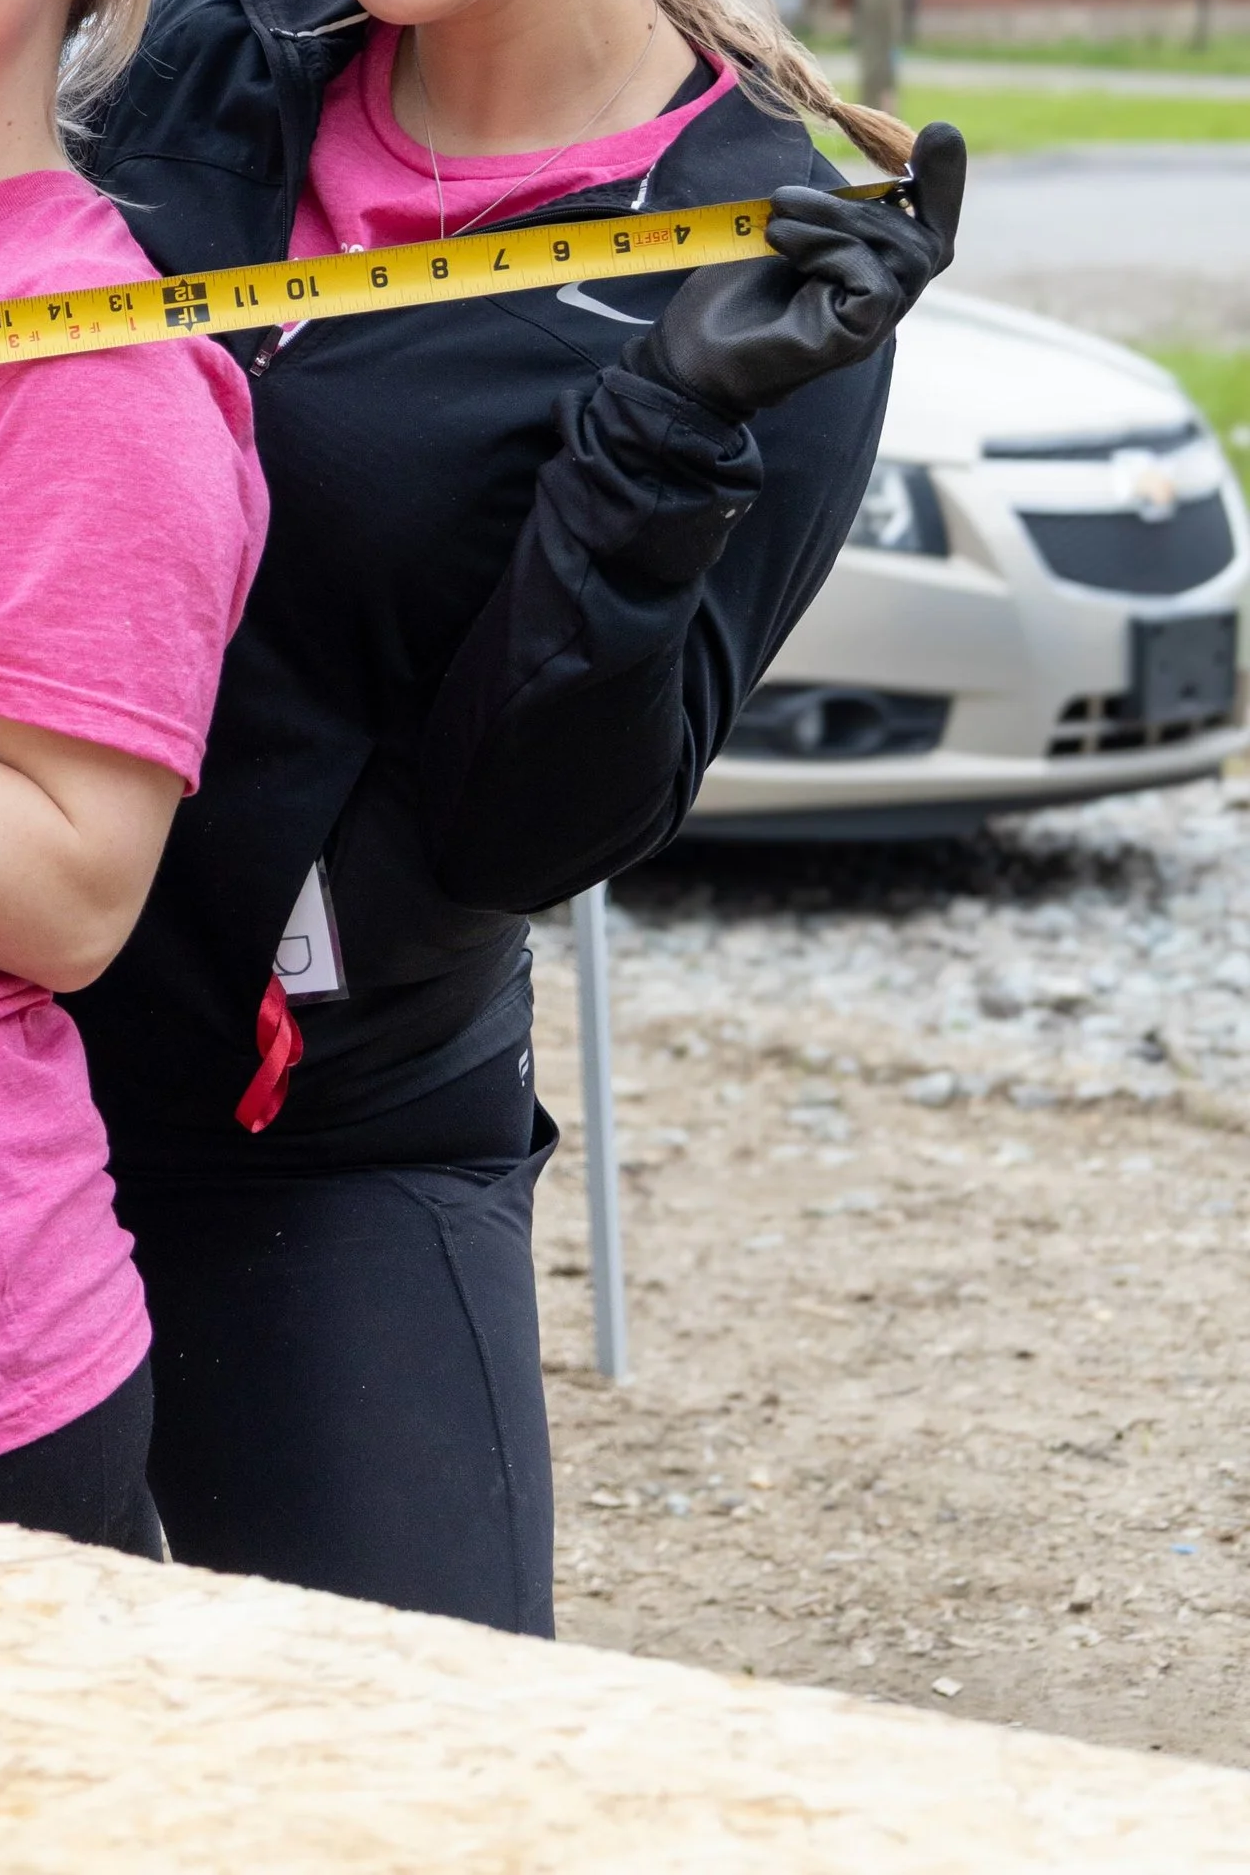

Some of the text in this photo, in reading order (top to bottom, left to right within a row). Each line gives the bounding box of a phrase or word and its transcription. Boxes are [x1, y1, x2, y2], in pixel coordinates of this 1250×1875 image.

[673, 224, 691, 246] 4
[734, 214, 752, 237] 3
[613, 232, 631, 254] 5
[635, 229, 670, 246] 25FT
[493, 248, 510, 271] 7
[552, 240, 570, 262] 6
[371, 266, 389, 288] 9
[431, 257, 449, 280] 8
[174, 285, 195, 302] 12
[234, 284, 259, 308] 11
[286, 275, 319, 300] 10
[47, 301, 73, 321] 14
[108, 292, 134, 313] 13
[69, 325, 80, 339] 2
[129, 317, 137, 331] 1
[8, 334, 20, 348] 3
